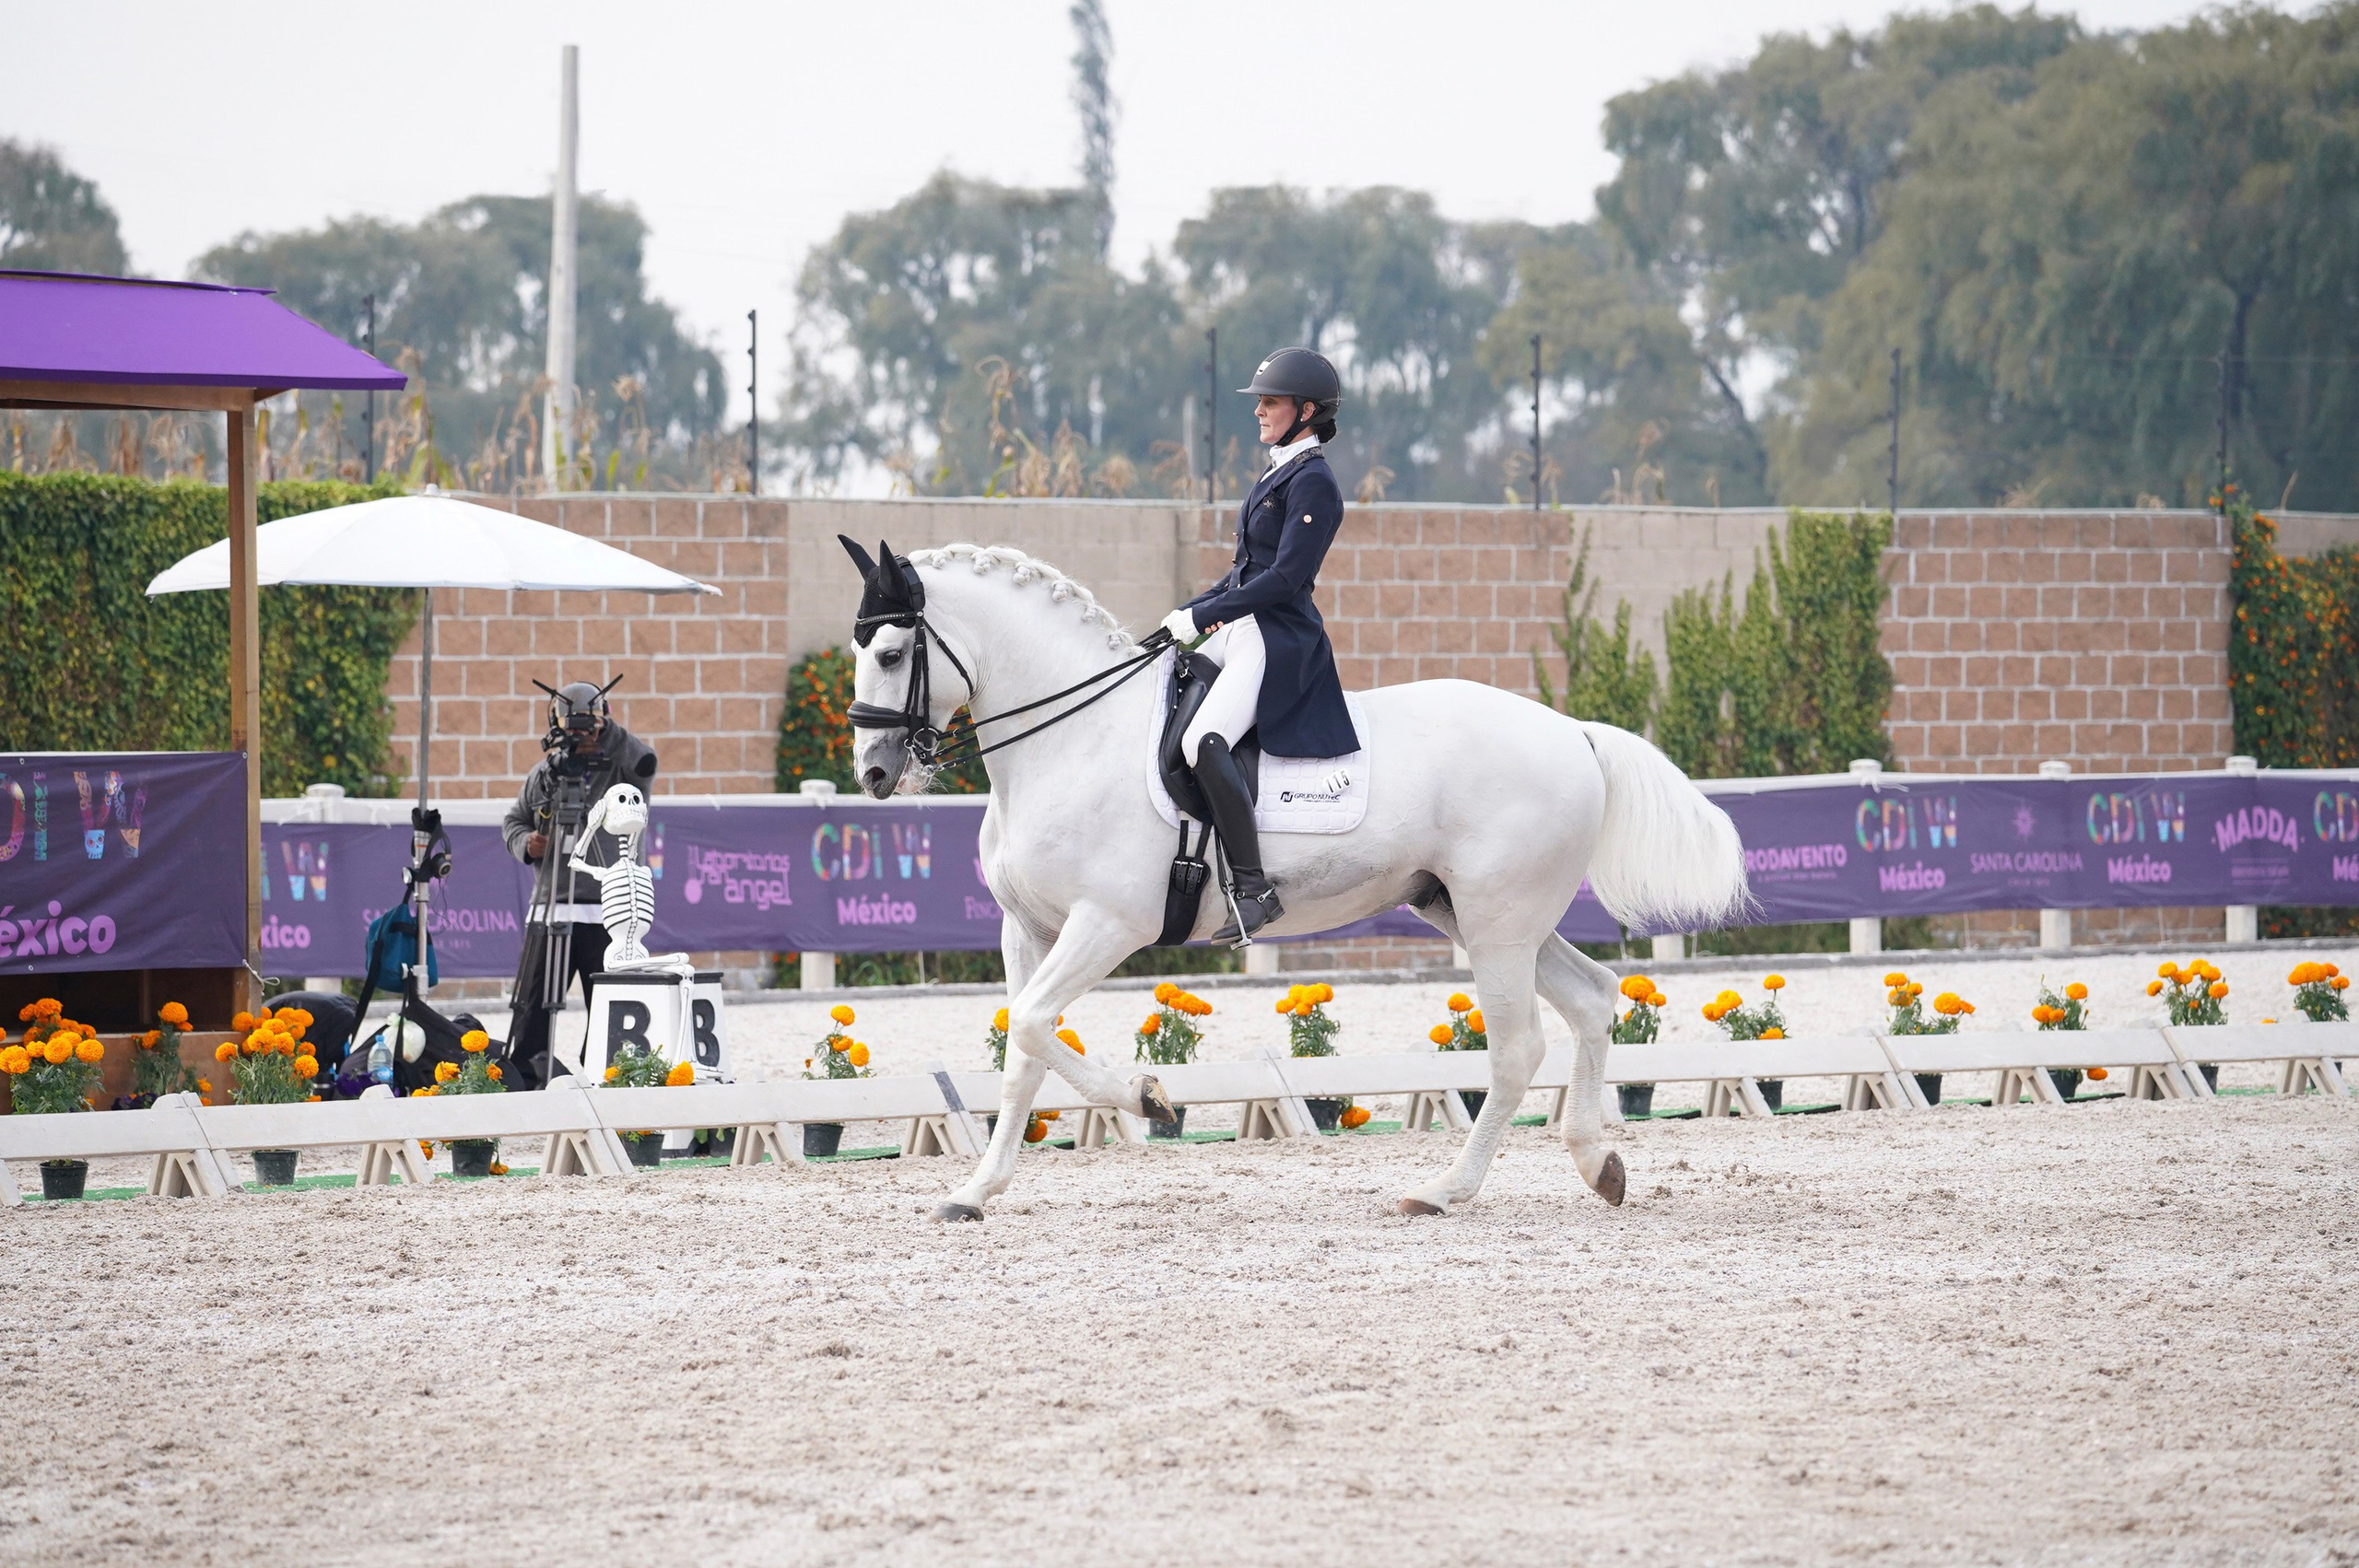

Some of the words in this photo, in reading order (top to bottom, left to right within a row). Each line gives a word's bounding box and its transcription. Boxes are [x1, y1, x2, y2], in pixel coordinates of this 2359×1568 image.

[1325, 770, 1350, 793] 115
[0, 771, 48, 861] DI
[73, 770, 148, 860] W
[1856, 798, 1918, 852] CDI
[1923, 796, 1957, 849] W
[2086, 792, 2145, 846] CDI
[2151, 791, 2186, 843] W
[2214, 804, 2298, 853] MADDA
[2313, 790, 2359, 842] CD
[281, 841, 328, 901] W
[811, 823, 883, 881] CDI
[891, 823, 932, 879] W
[1745, 843, 1848, 872] RODAVENTO
[1879, 860, 1946, 892] México
[1969, 852, 2013, 873] SANTA
[2013, 851, 2084, 873] CAROLINA
[2107, 853, 2172, 883] México
[0, 900, 116, 958] éxico
[261, 914, 311, 950] xico
[837, 892, 917, 925] México
[605, 1000, 651, 1069] B
[692, 999, 720, 1067] B
